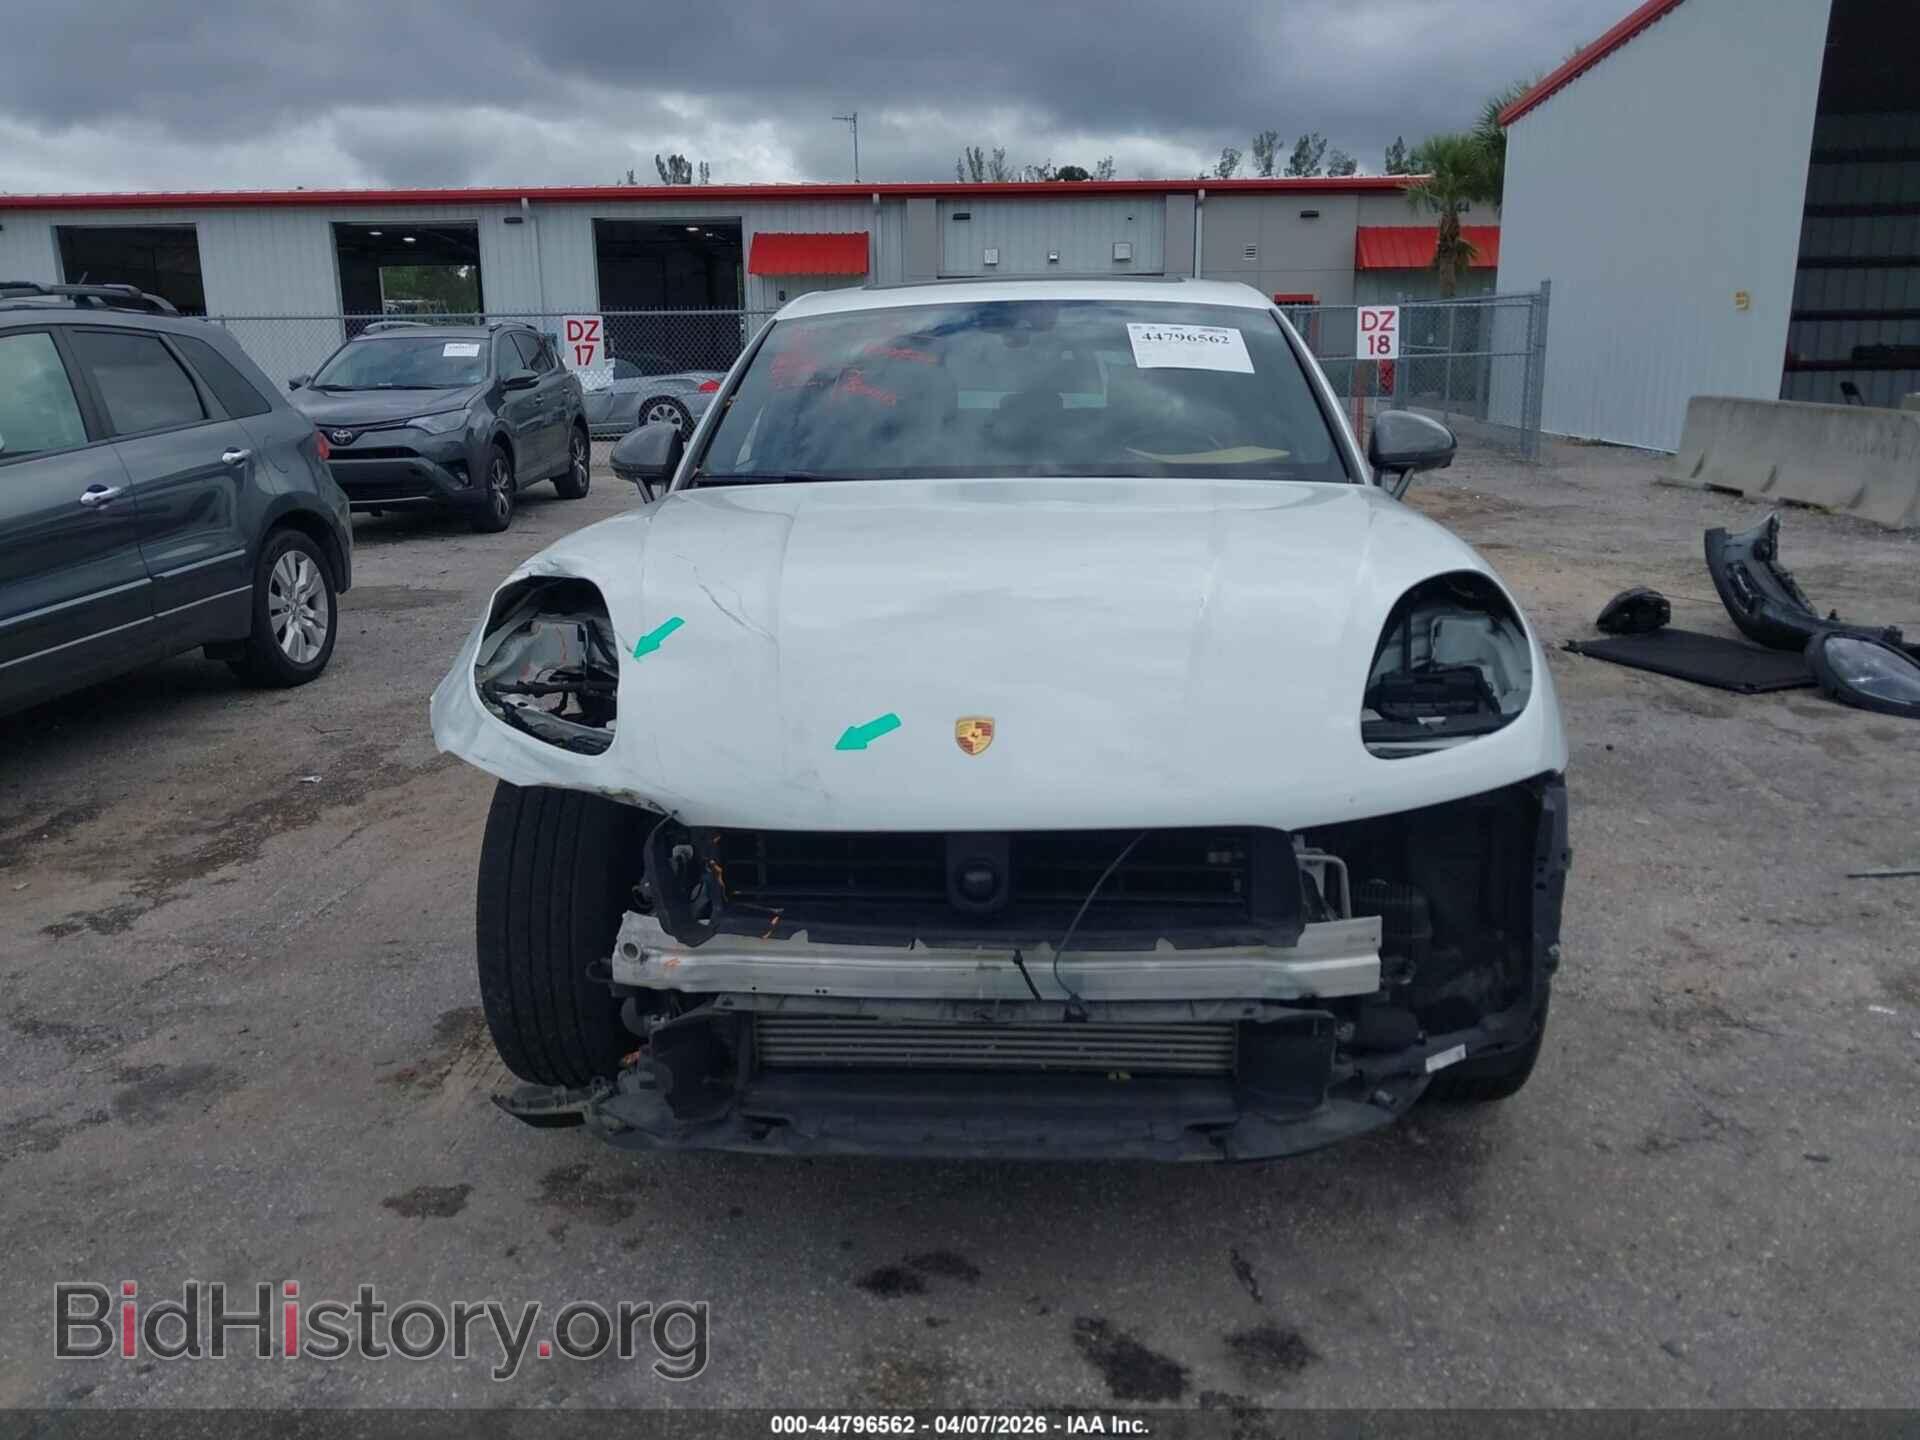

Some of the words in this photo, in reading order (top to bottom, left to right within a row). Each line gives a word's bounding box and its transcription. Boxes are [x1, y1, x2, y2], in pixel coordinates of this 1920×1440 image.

[567, 320, 600, 341] DZ
[1361, 311, 1395, 331] DZ
[1142, 333, 1230, 344] 44796562
[1368, 335, 1390, 355] 18
[575, 345, 594, 365] 17
